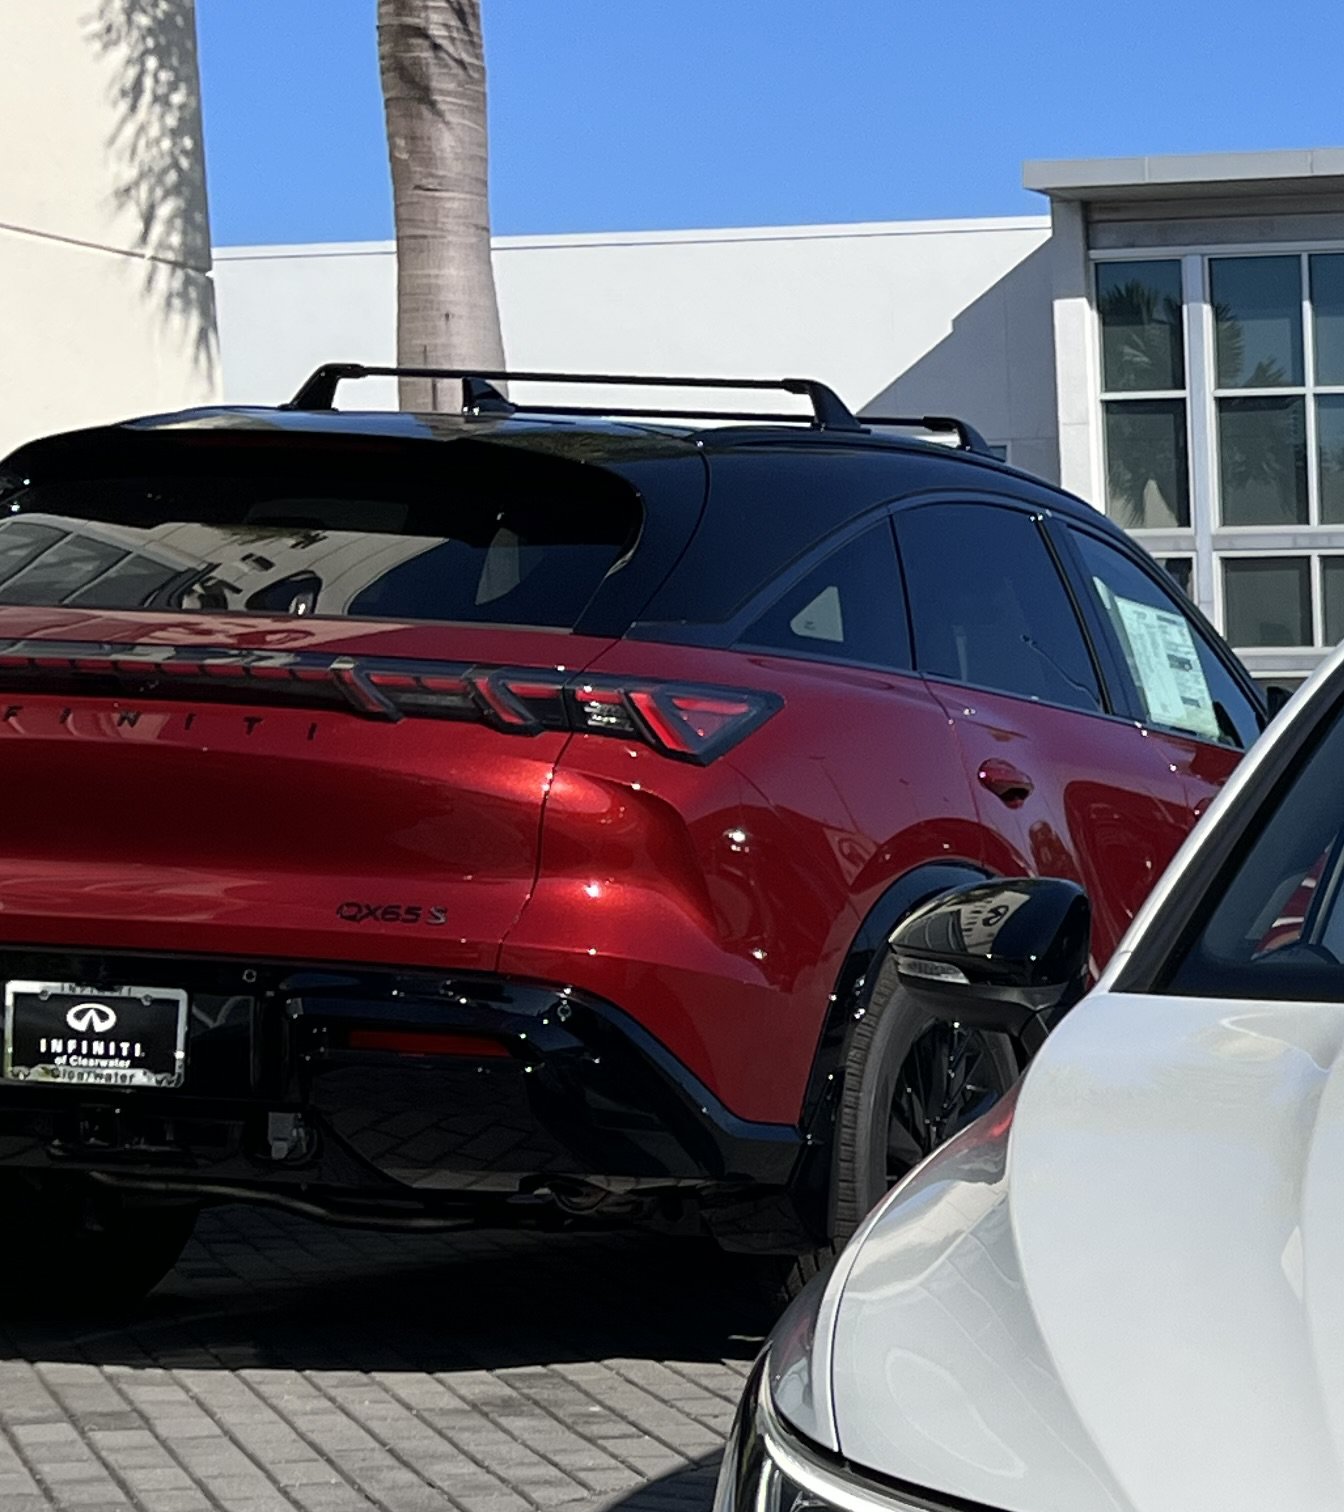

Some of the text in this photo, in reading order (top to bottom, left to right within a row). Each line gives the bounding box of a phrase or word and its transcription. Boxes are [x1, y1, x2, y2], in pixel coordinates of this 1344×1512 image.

[336, 902, 448, 926] QX65 S
[39, 1037, 141, 1057] INFINITI
[54, 1055, 131, 1068] of Clearwater
